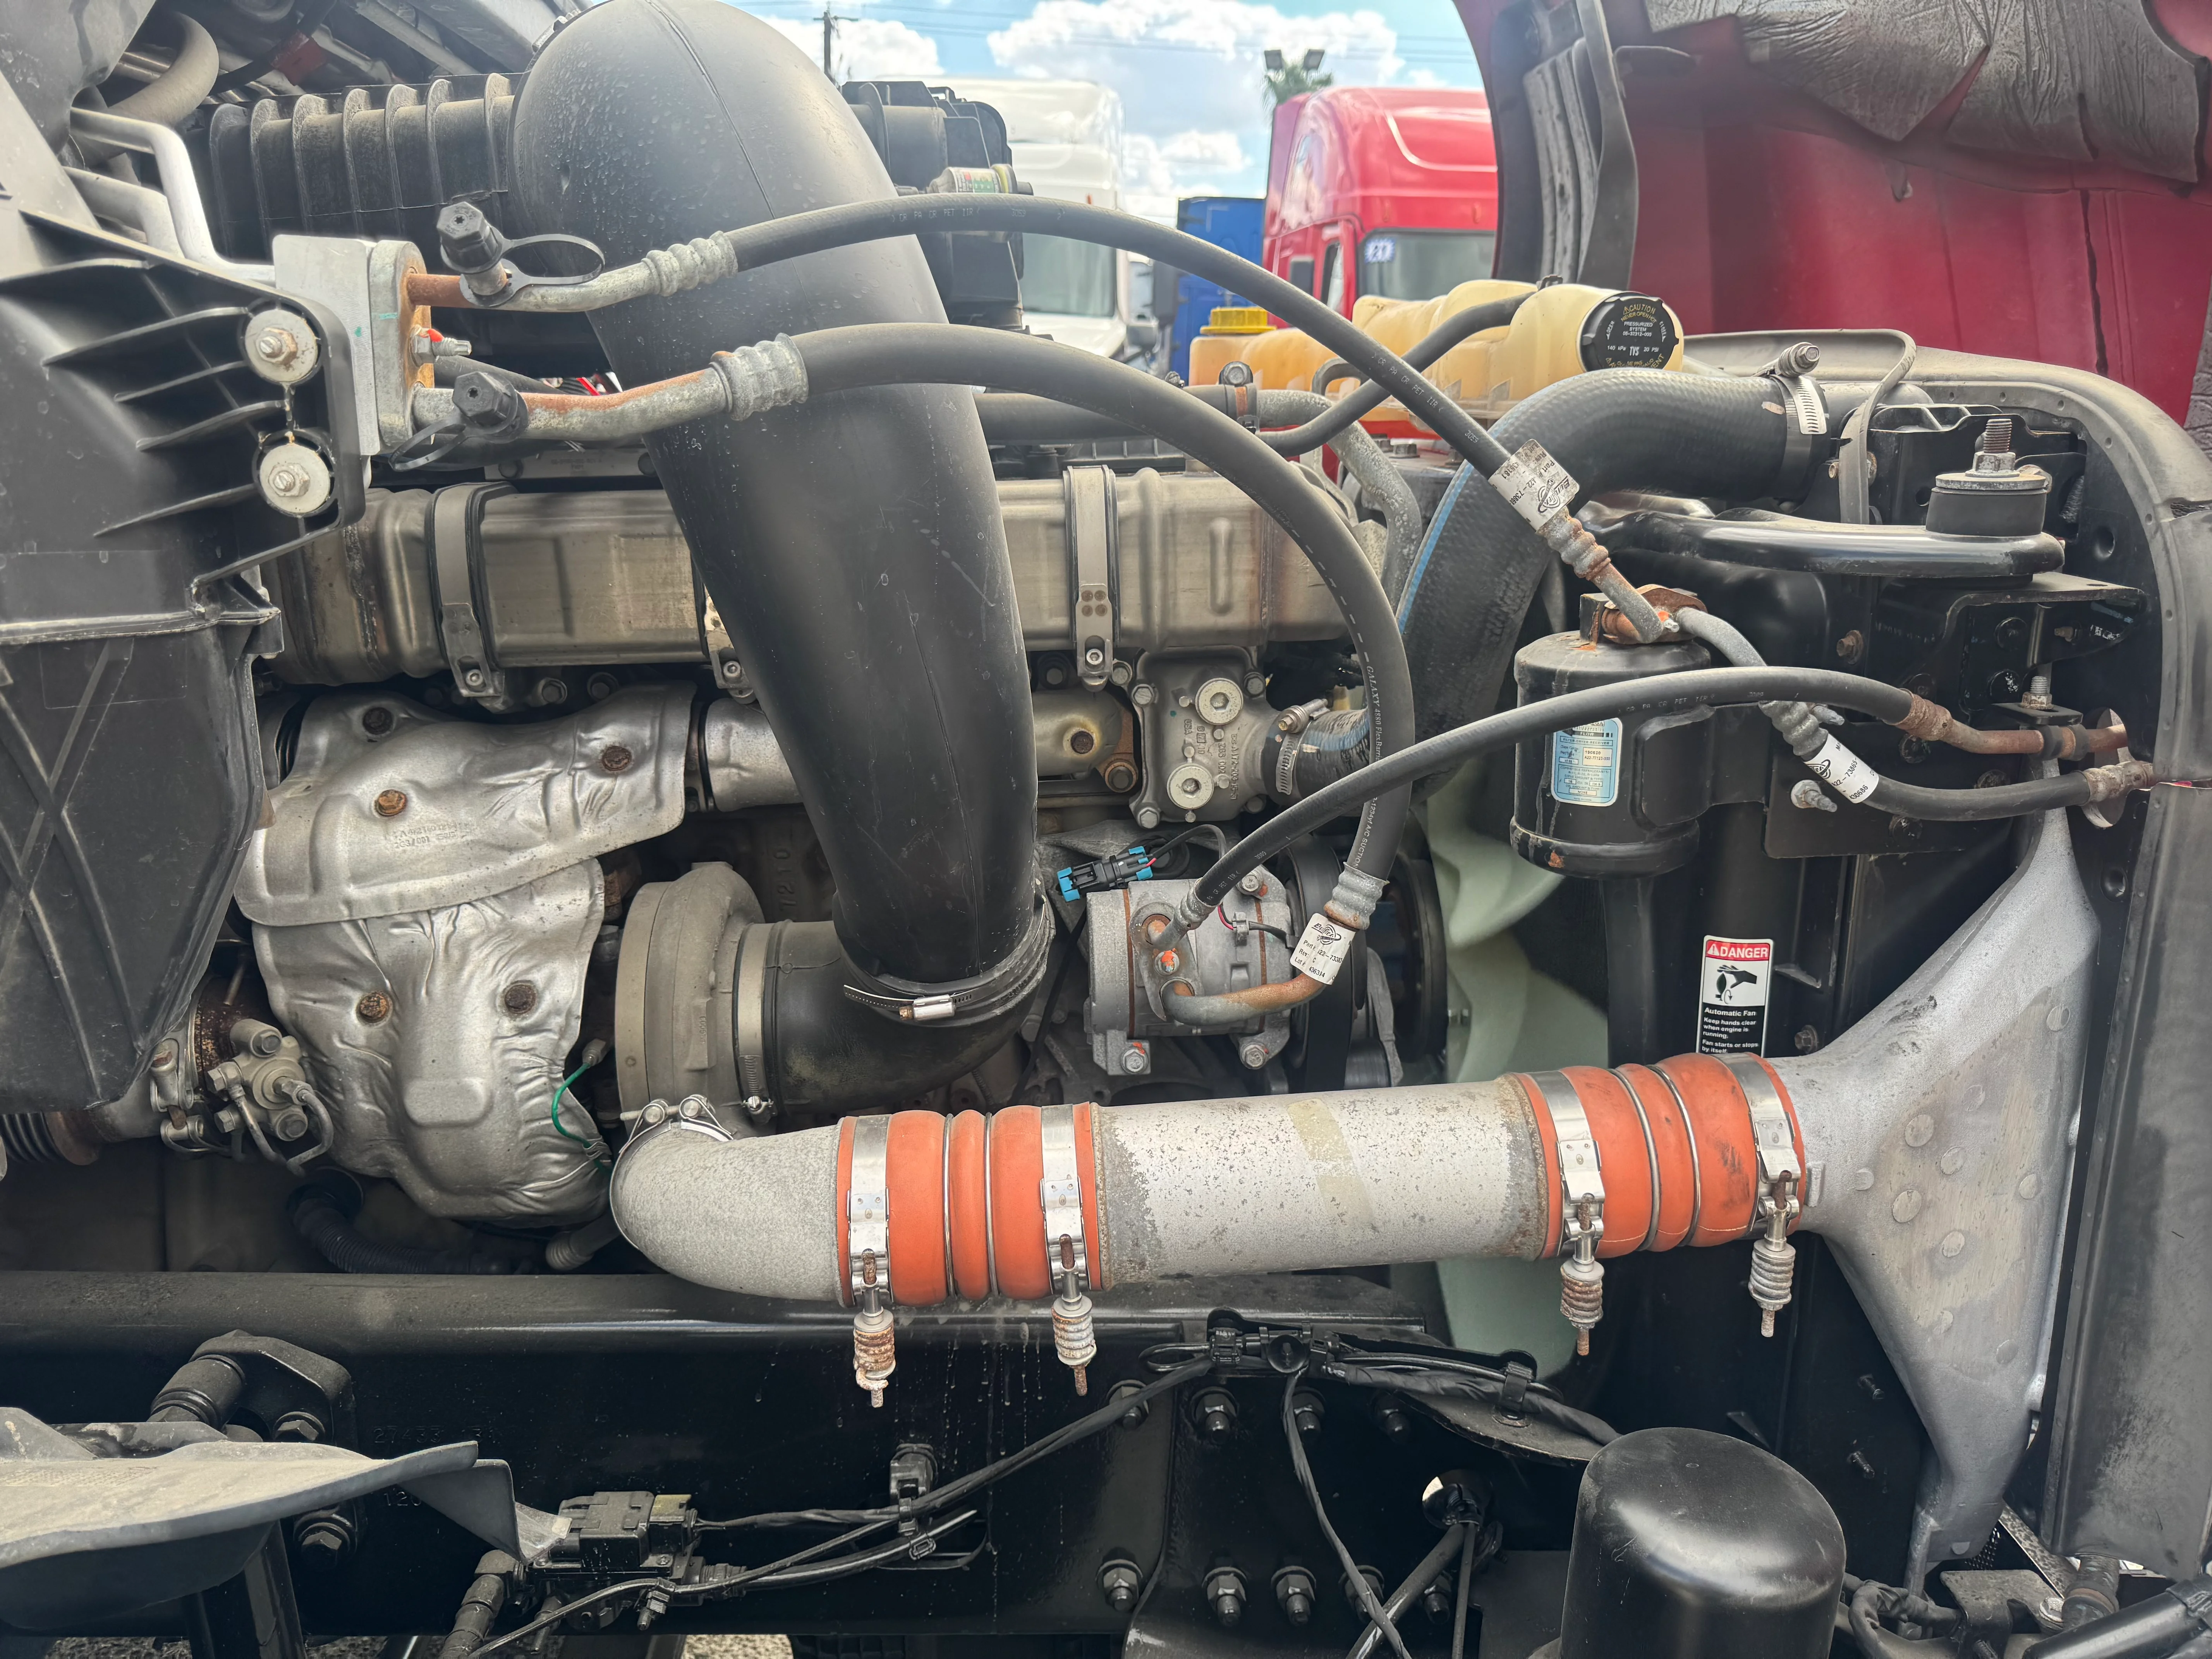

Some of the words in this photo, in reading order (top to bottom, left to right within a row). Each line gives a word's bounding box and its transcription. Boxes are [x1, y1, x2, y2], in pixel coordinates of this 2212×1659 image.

[944, 208, 955, 217] PET
[1629, 304, 1656, 314] CAUTION
[1621, 312, 1636, 322] NEVER
[1629, 346, 1640, 356] TVS
[1401, 376, 1410, 384] CR
[1412, 384, 1425, 395] PET
[1542, 460, 1555, 472] Part
[1366, 665, 1380, 707] GALAXY
[1184, 719, 1192, 735] USA
[1304, 940, 1314, 949] Part
[1720, 946, 1768, 958] DANGER
[1704, 1007, 1741, 1016] Automatic
